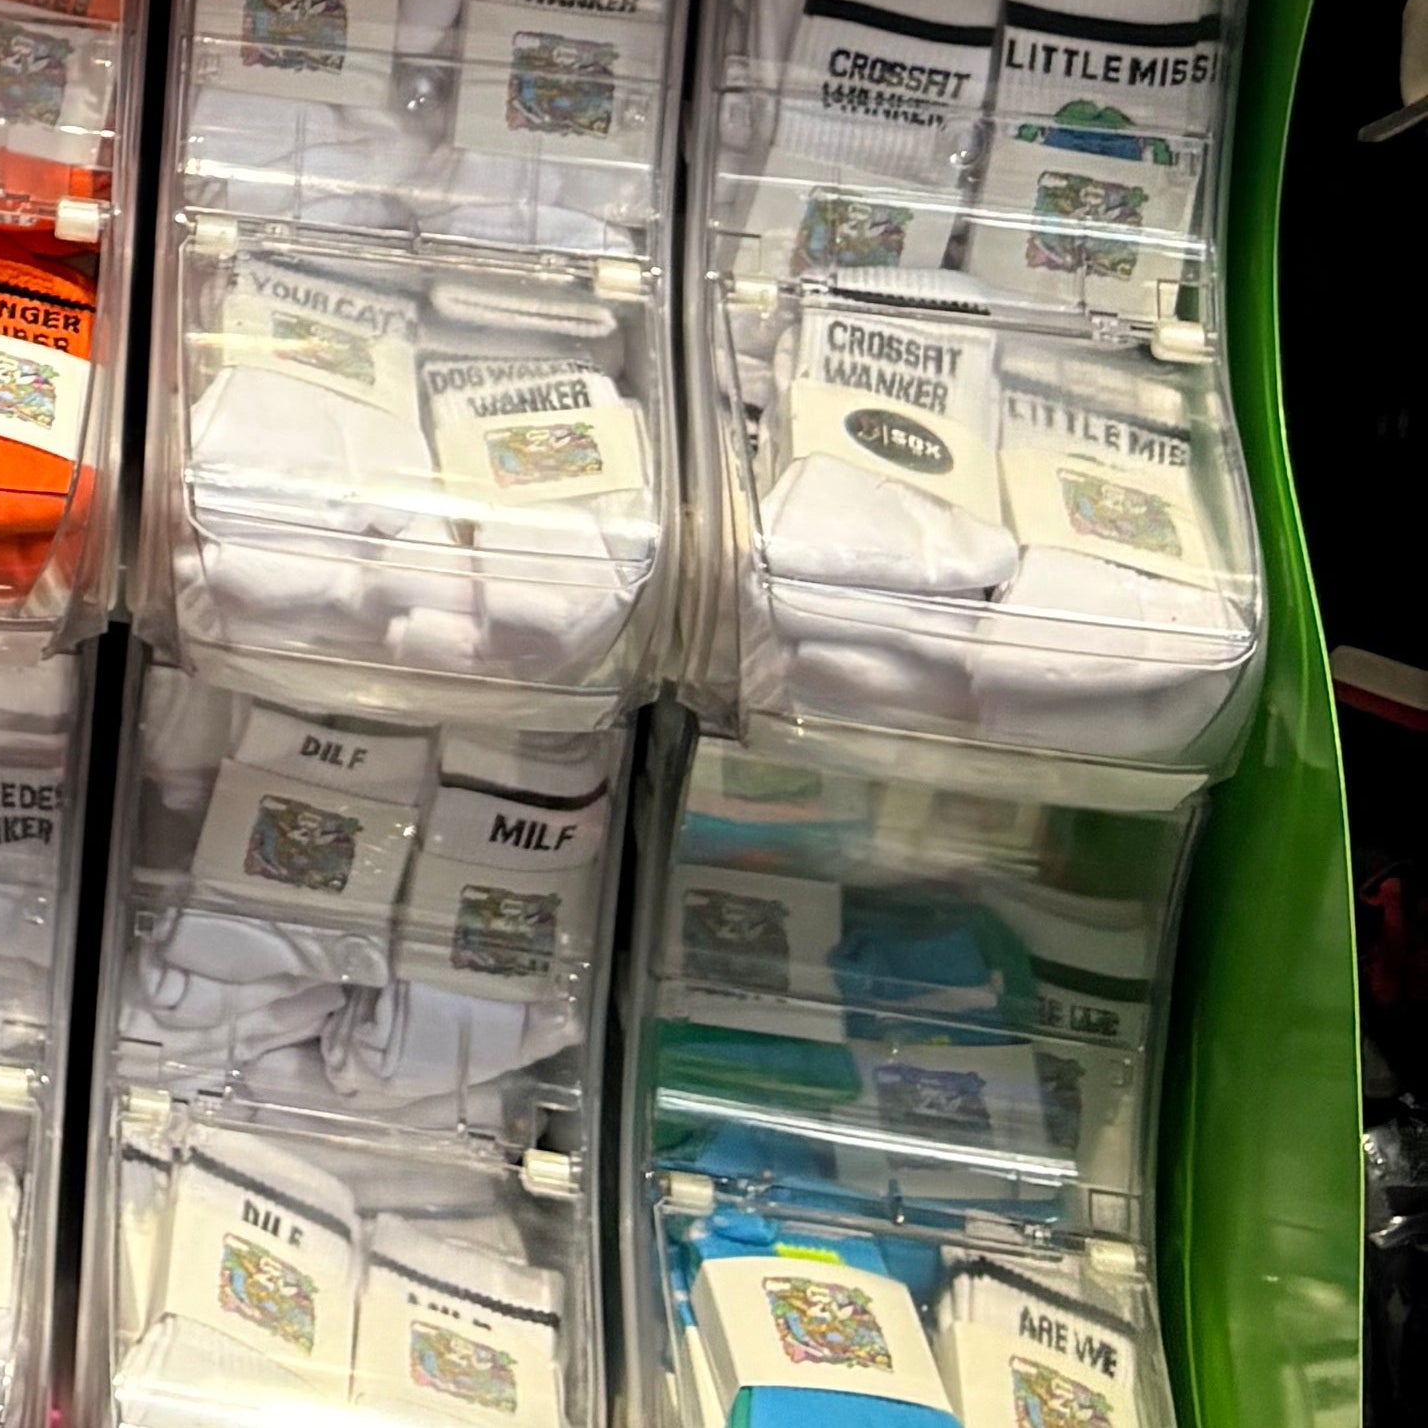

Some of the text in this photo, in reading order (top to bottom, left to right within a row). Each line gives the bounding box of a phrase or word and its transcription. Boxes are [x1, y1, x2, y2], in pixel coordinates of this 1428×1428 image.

[827, 47, 973, 100] CROSSFIT
[1004, 37, 1122, 83] LITTLE
[826, 319, 964, 378] CROSSFIT
[468, 378, 590, 418] WANKER
[823, 359, 950, 415] WANKER
[1007, 394, 1122, 449] LITTLE
[298, 734, 370, 772] DILF
[488, 813, 579, 852] MILF
[1018, 1305, 1118, 1380] ARE WE
